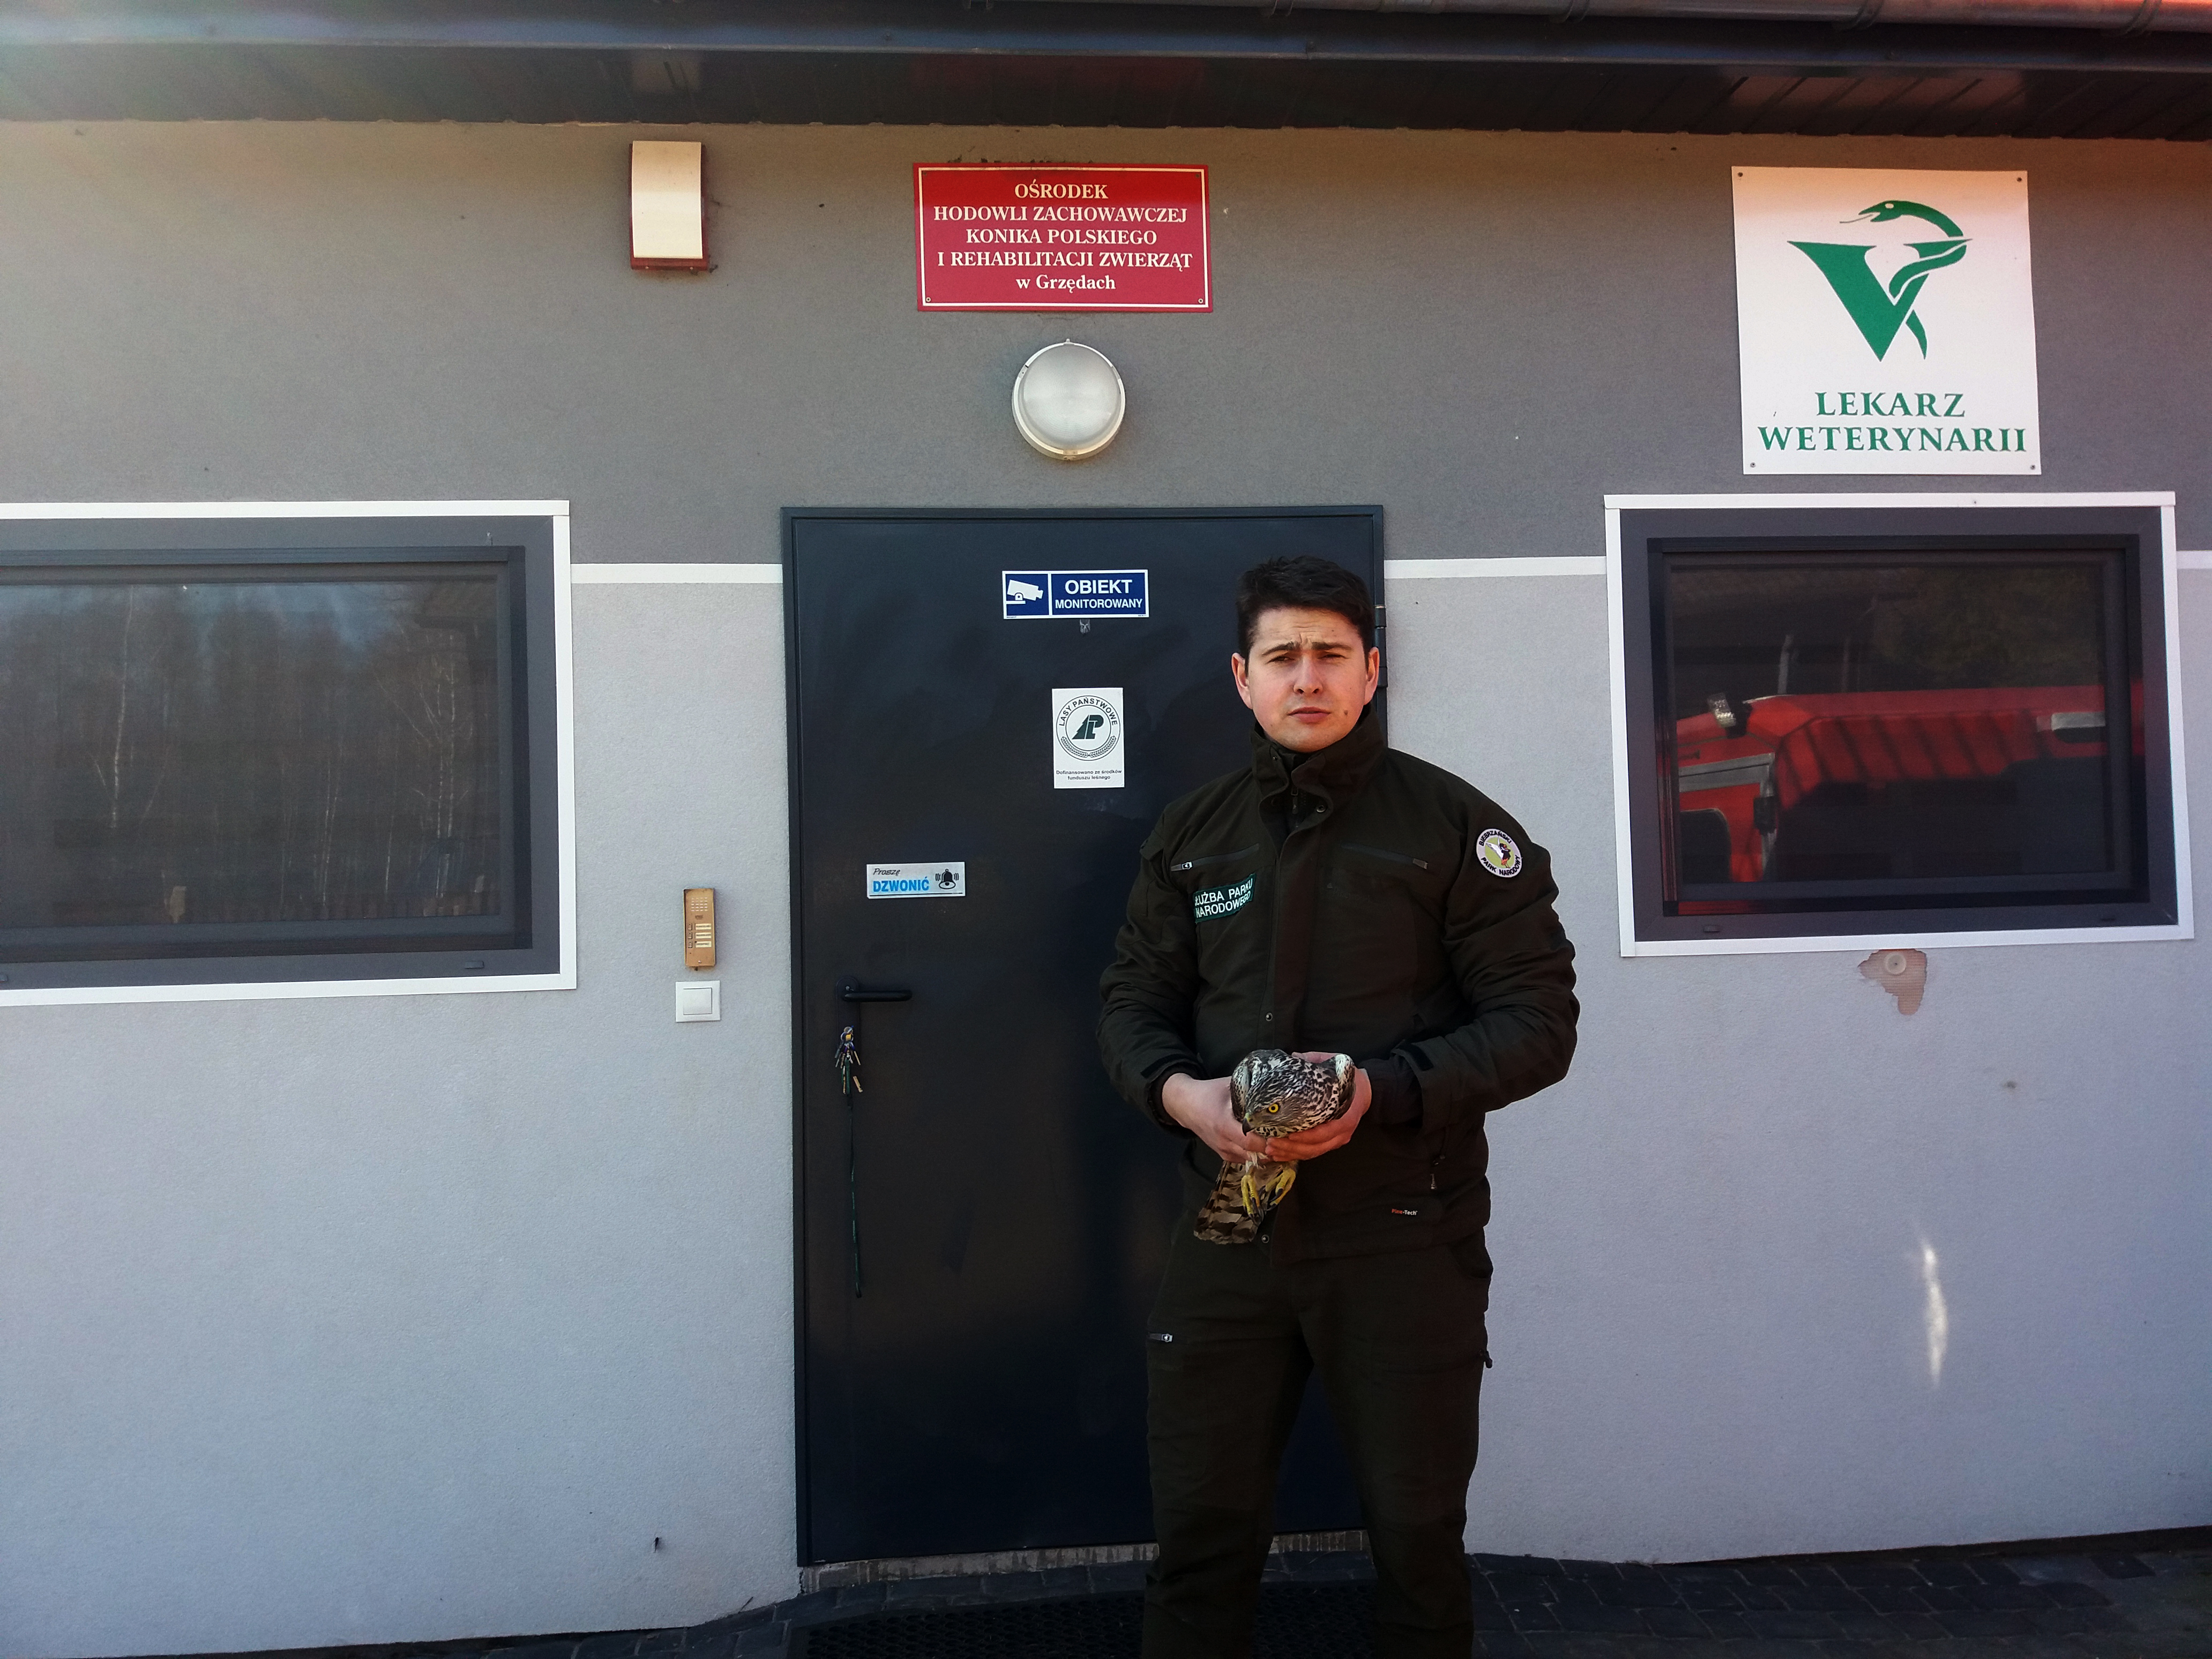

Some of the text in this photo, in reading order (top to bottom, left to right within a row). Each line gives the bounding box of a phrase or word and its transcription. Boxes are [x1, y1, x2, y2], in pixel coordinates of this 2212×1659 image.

[1014, 178, 1109, 199] OŚRODEK
[933, 205, 1187, 223] HODOWLI ZACHOWAWCZEJ
[966, 228, 1157, 245] KONIKA POLSKIEGO
[937, 251, 1193, 272] I REHABILITACJI ZWIERZĄT
[1016, 274, 1116, 293] w Grzędach
[1814, 392, 1966, 418] LEKARZ
[1757, 425, 2027, 452] WETERYNARII
[1065, 579, 1133, 594] OBIEKT
[1055, 598, 1143, 609] MONITOROWANY
[1058, 697, 1118, 727] LASY PAŃSTWOWE
[1478, 830, 1512, 847] BIEBRZAŃSKI
[873, 868, 901, 877] Proszę
[1481, 854, 1521, 876] PARK NARODOWY
[872, 876, 930, 892] DZWONIĆ
[1228, 878, 1253, 900] PARKU
[1195, 890, 1251, 918] NARODOWEGO
